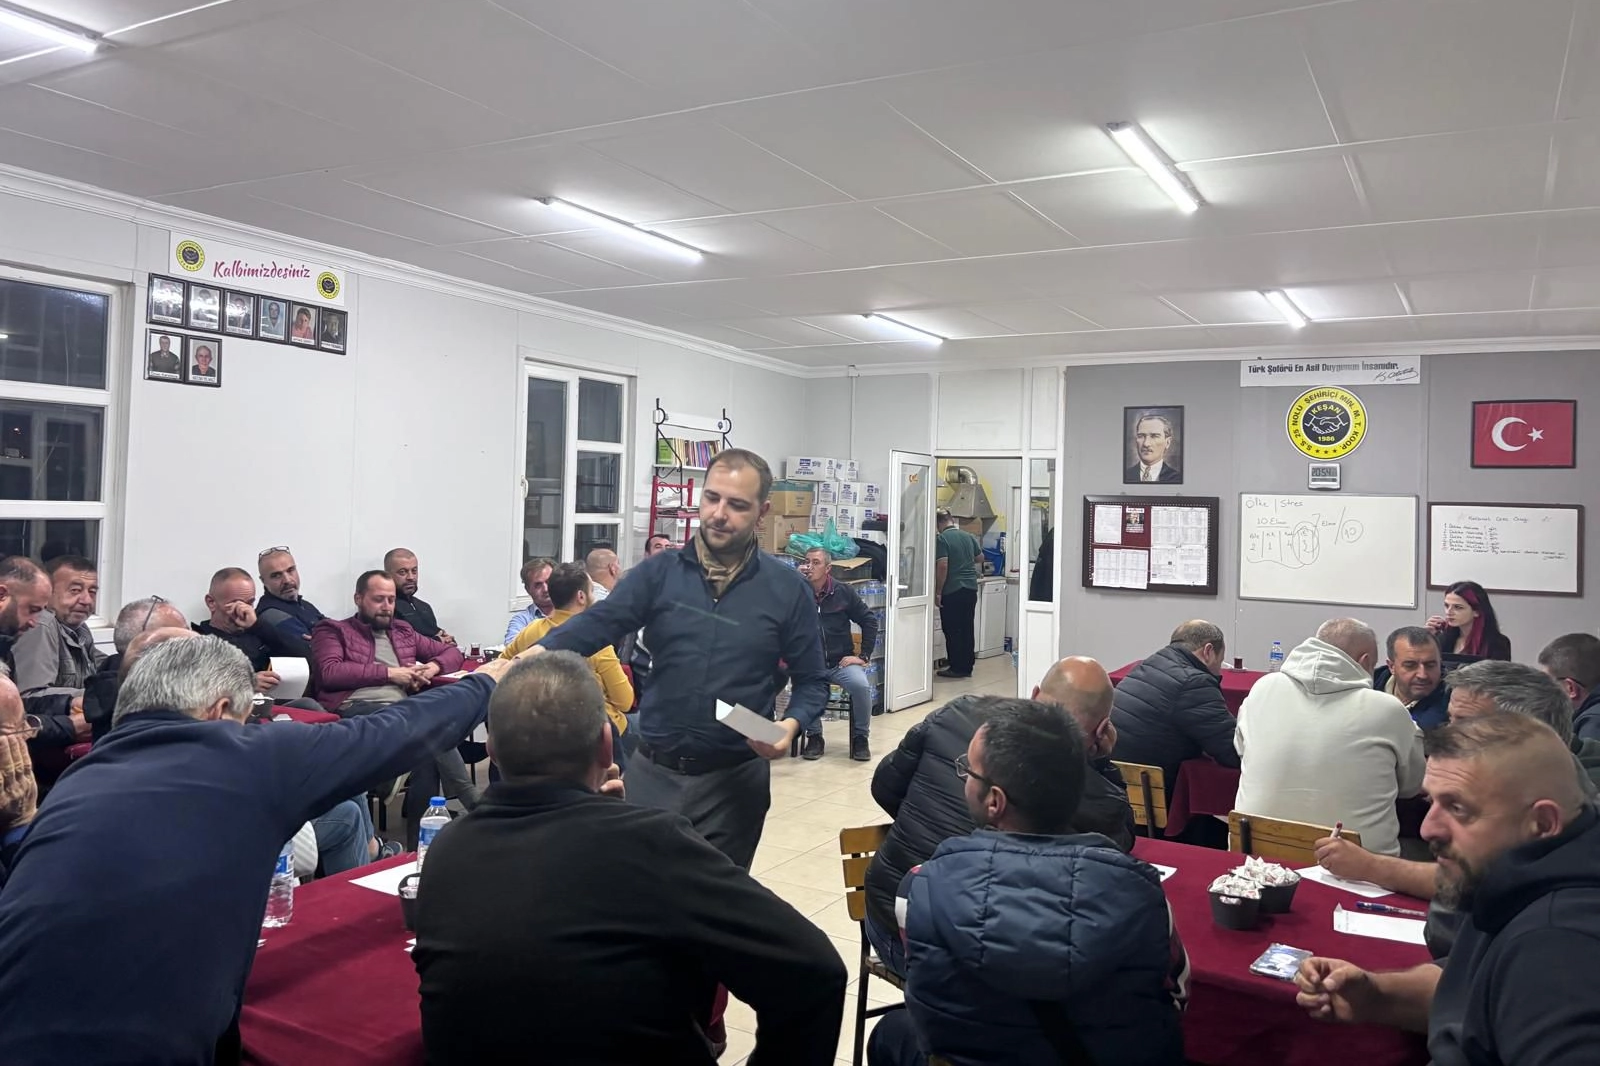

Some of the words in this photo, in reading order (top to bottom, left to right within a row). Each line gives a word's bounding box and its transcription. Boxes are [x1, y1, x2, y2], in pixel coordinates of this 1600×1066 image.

[212, 260, 311, 279] Kalbimizdesiniz
[1248, 364, 1266, 373] Türk
[1267, 363, 1293, 375] Şoförü
[1295, 363, 1304, 372] En
[1305, 363, 1320, 372] Asil
[1304, 390, 1338, 404] ŞEHİRİÇİ
[1291, 405, 1303, 426] NOLU
[1311, 403, 1342, 415] KEŞAN
[1293, 428, 1301, 439] 25
[1339, 431, 1360, 450] KOOP.
[1280, 498, 1304, 508] Stres
